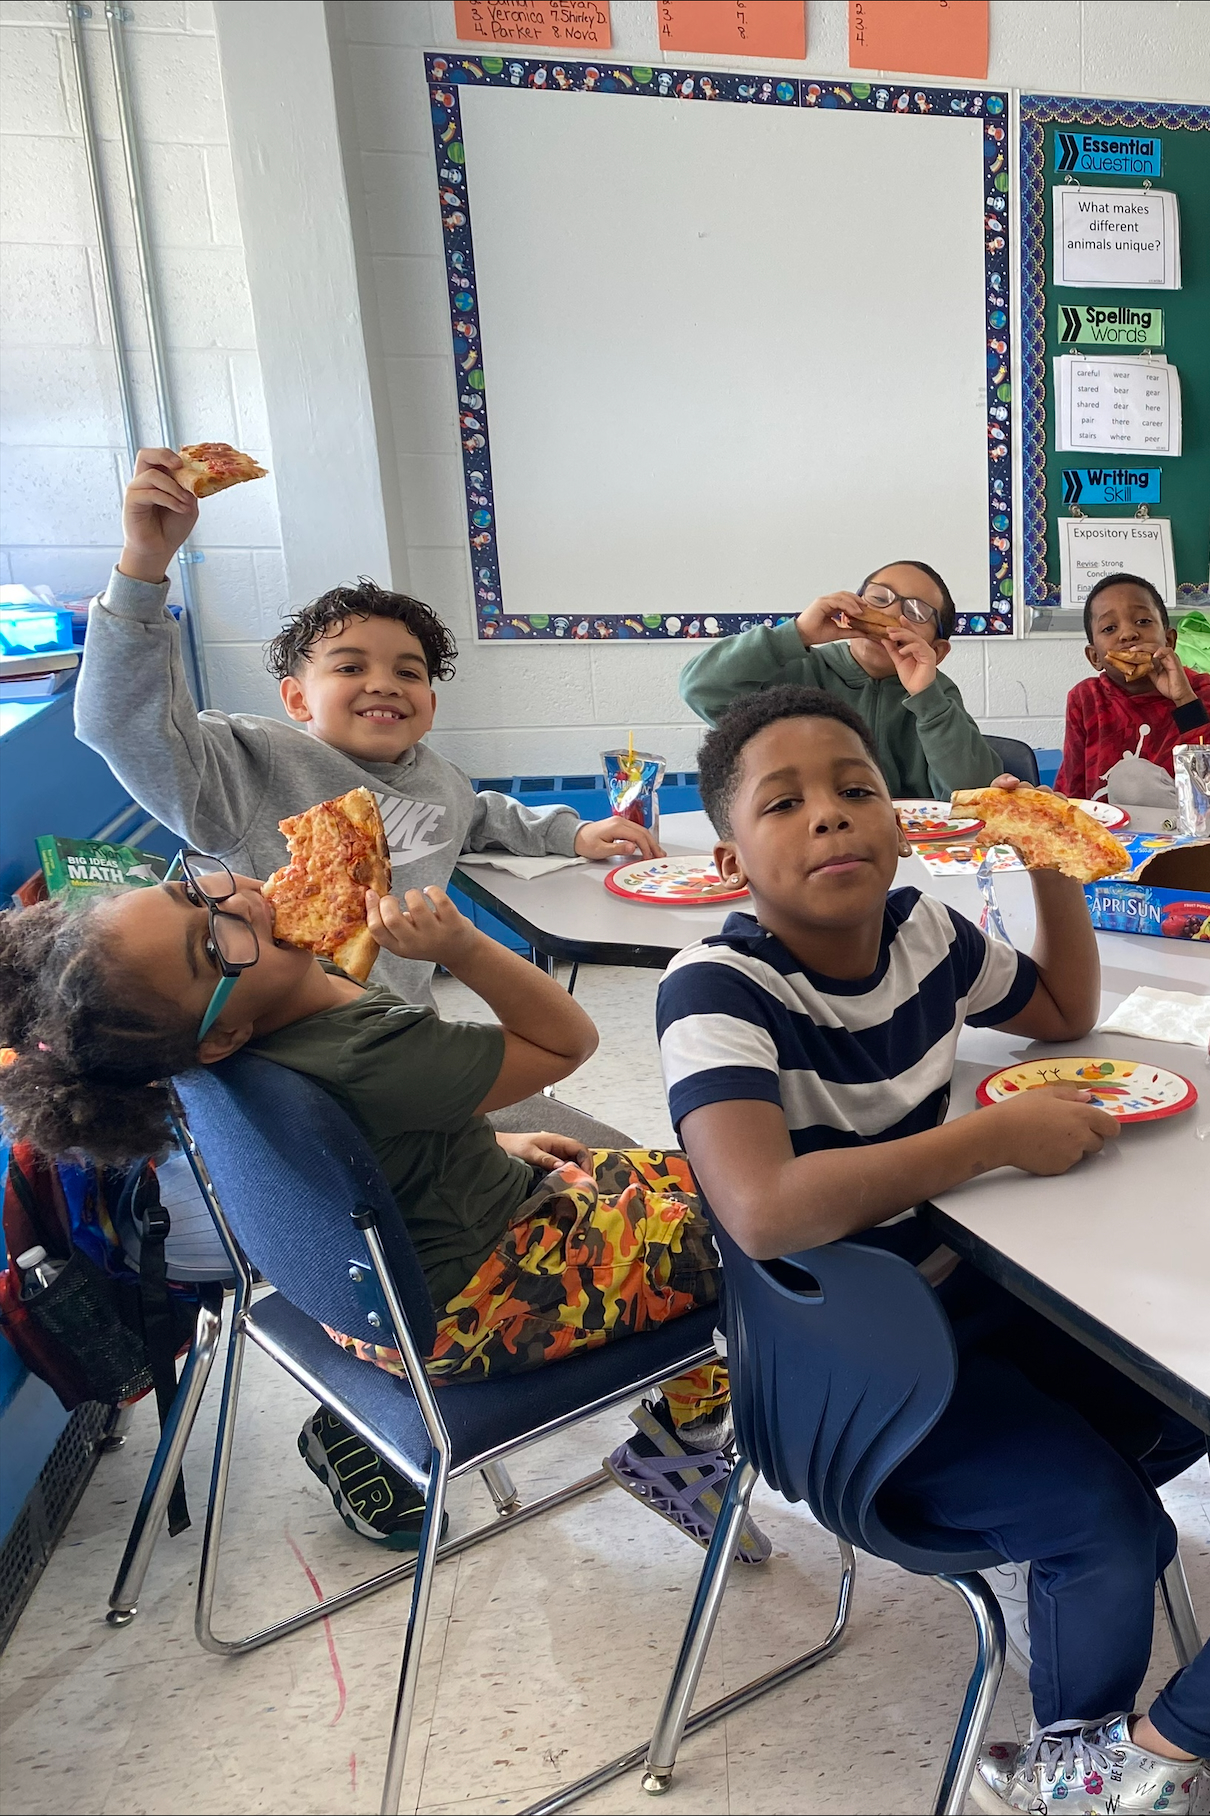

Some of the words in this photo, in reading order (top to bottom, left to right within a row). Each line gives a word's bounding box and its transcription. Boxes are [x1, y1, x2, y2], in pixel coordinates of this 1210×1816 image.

[487, 7, 545, 25] Veronica
[561, 10, 594, 29] Shirley
[475, 23, 488, 36] 4.
[491, 21, 542, 40] Parker
[552, 26, 562, 37] 8.
[566, 27, 598, 42] Nova
[662, 25, 673, 37] 4.
[738, 26, 748, 39] 8.
[857, 31, 868, 46] 4.
[1082, 136, 1154, 156] Essential
[1081, 154, 1153, 173] Question
[1078, 201, 1110, 214] What
[1113, 202, 1149, 215] makes
[1089, 219, 1139, 232] different
[1067, 239, 1112, 251] animals
[1115, 239, 1161, 254] unique?
[1086, 306, 1152, 328] Spelling
[1091, 326, 1147, 343] Words
[1077, 369, 1100, 377] careful
[1146, 374, 1159, 382] rear
[1113, 387, 1129, 395] bear
[1145, 390, 1160, 398] gear
[1077, 401, 1100, 409] shared
[1113, 402, 1129, 410] dear
[1145, 404, 1161, 412] here
[1081, 417, 1095, 425] pair
[1112, 418, 1130, 426] there
[1079, 432, 1097, 440] stairs
[1144, 436, 1160, 444] peer
[1087, 469, 1149, 488] Writing
[1104, 486, 1132, 502] Skill
[1074, 528, 1128, 540] Expository
[1131, 528, 1159, 541] Essay
[1101, 560, 1124, 568] Strong
[67, 856, 87, 865] BIG
[90, 858, 119, 868] IDEAS
[67, 865, 124, 884] MATH
